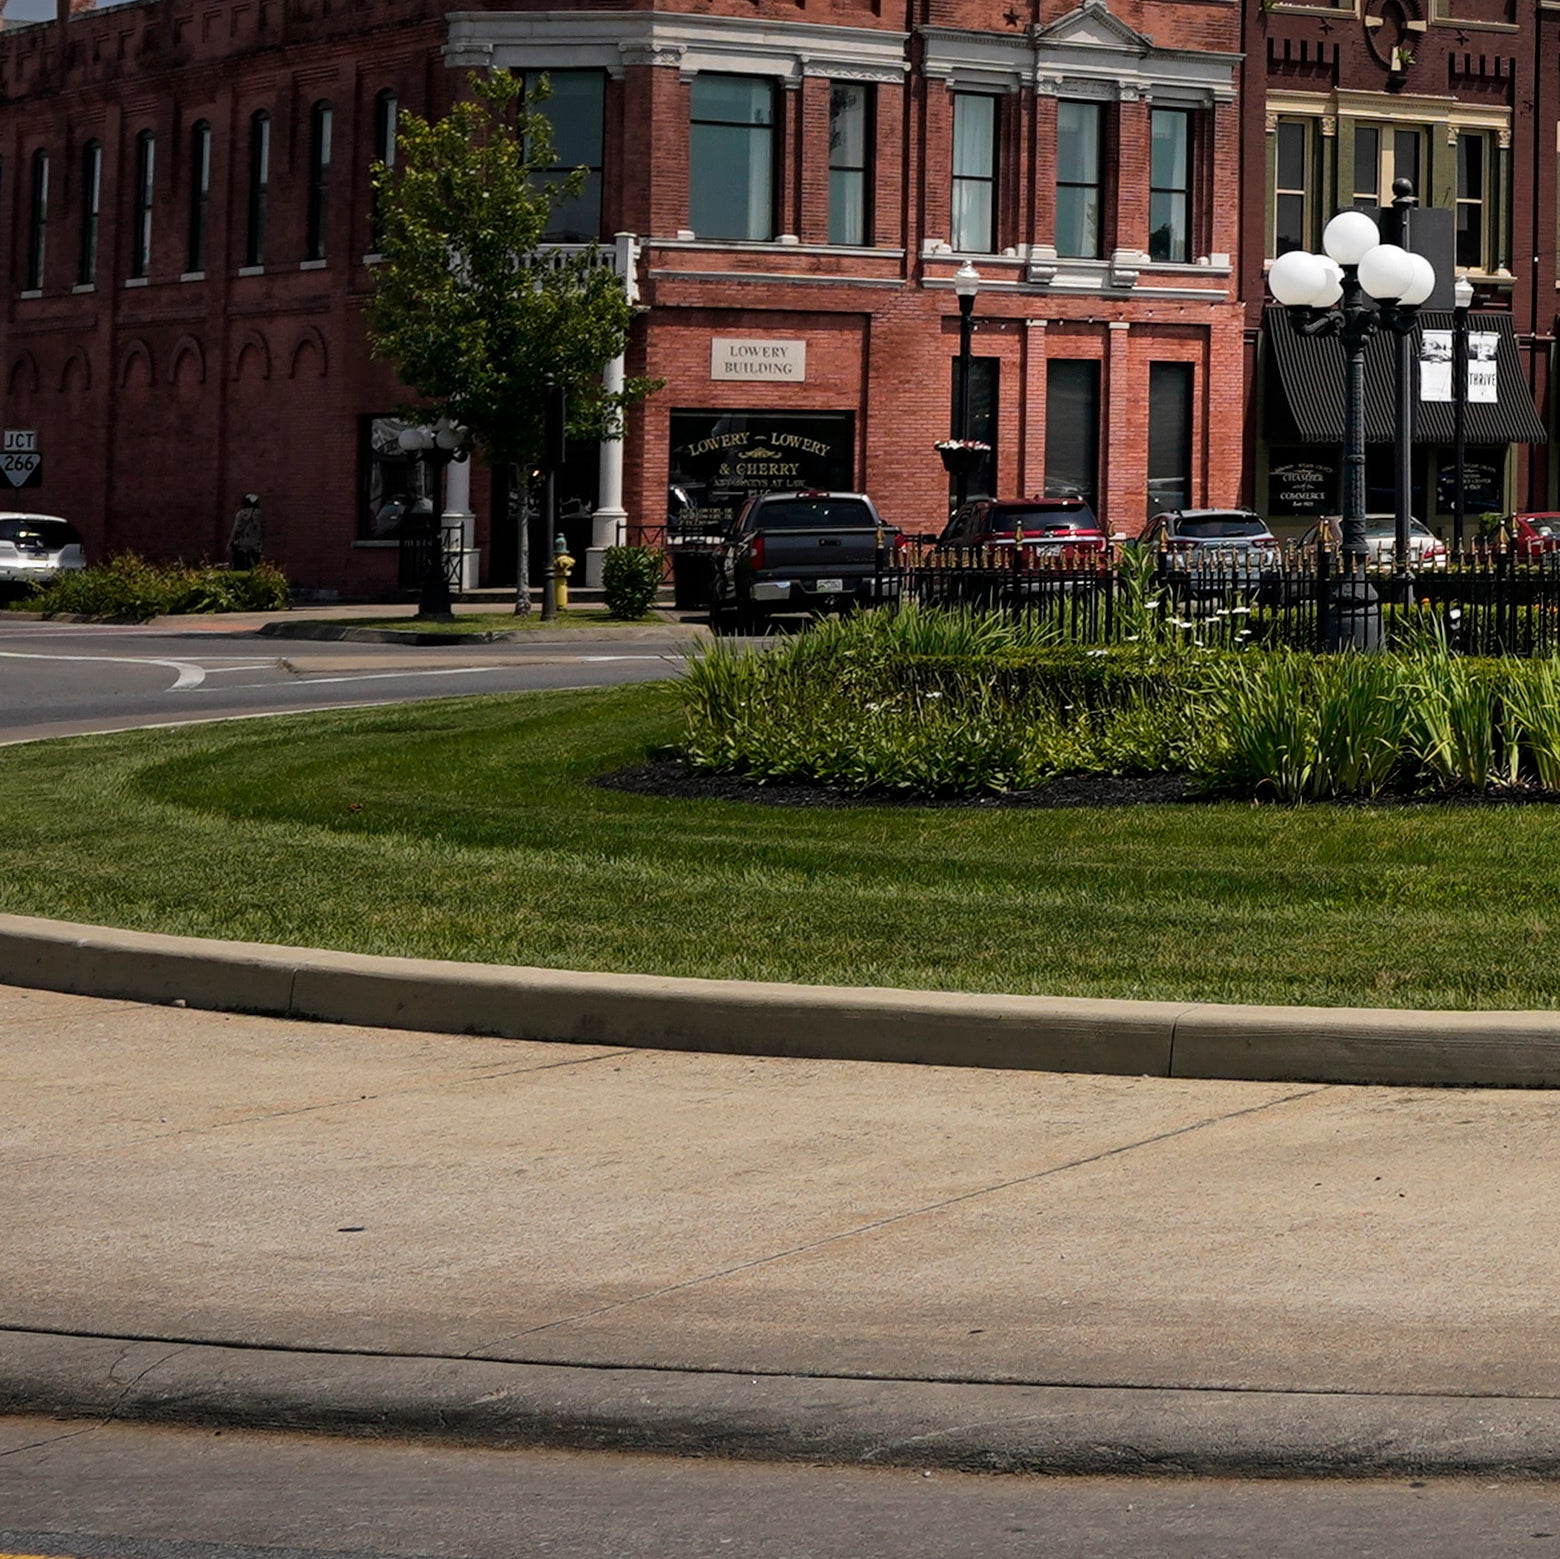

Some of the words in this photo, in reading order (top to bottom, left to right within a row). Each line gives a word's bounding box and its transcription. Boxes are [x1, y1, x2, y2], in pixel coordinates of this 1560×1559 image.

[729, 345, 789, 358] LOWERY
[724, 361, 793, 375] BUILDING
[1469, 373, 1497, 387] THRIVE
[5, 433, 34, 448] JCT
[687, 432, 751, 458] LOWERY
[770, 431, 831, 458] LOWERY
[5, 455, 34, 471] 266
[718, 463, 731, 476] &
[735, 462, 801, 476] CHERRY
